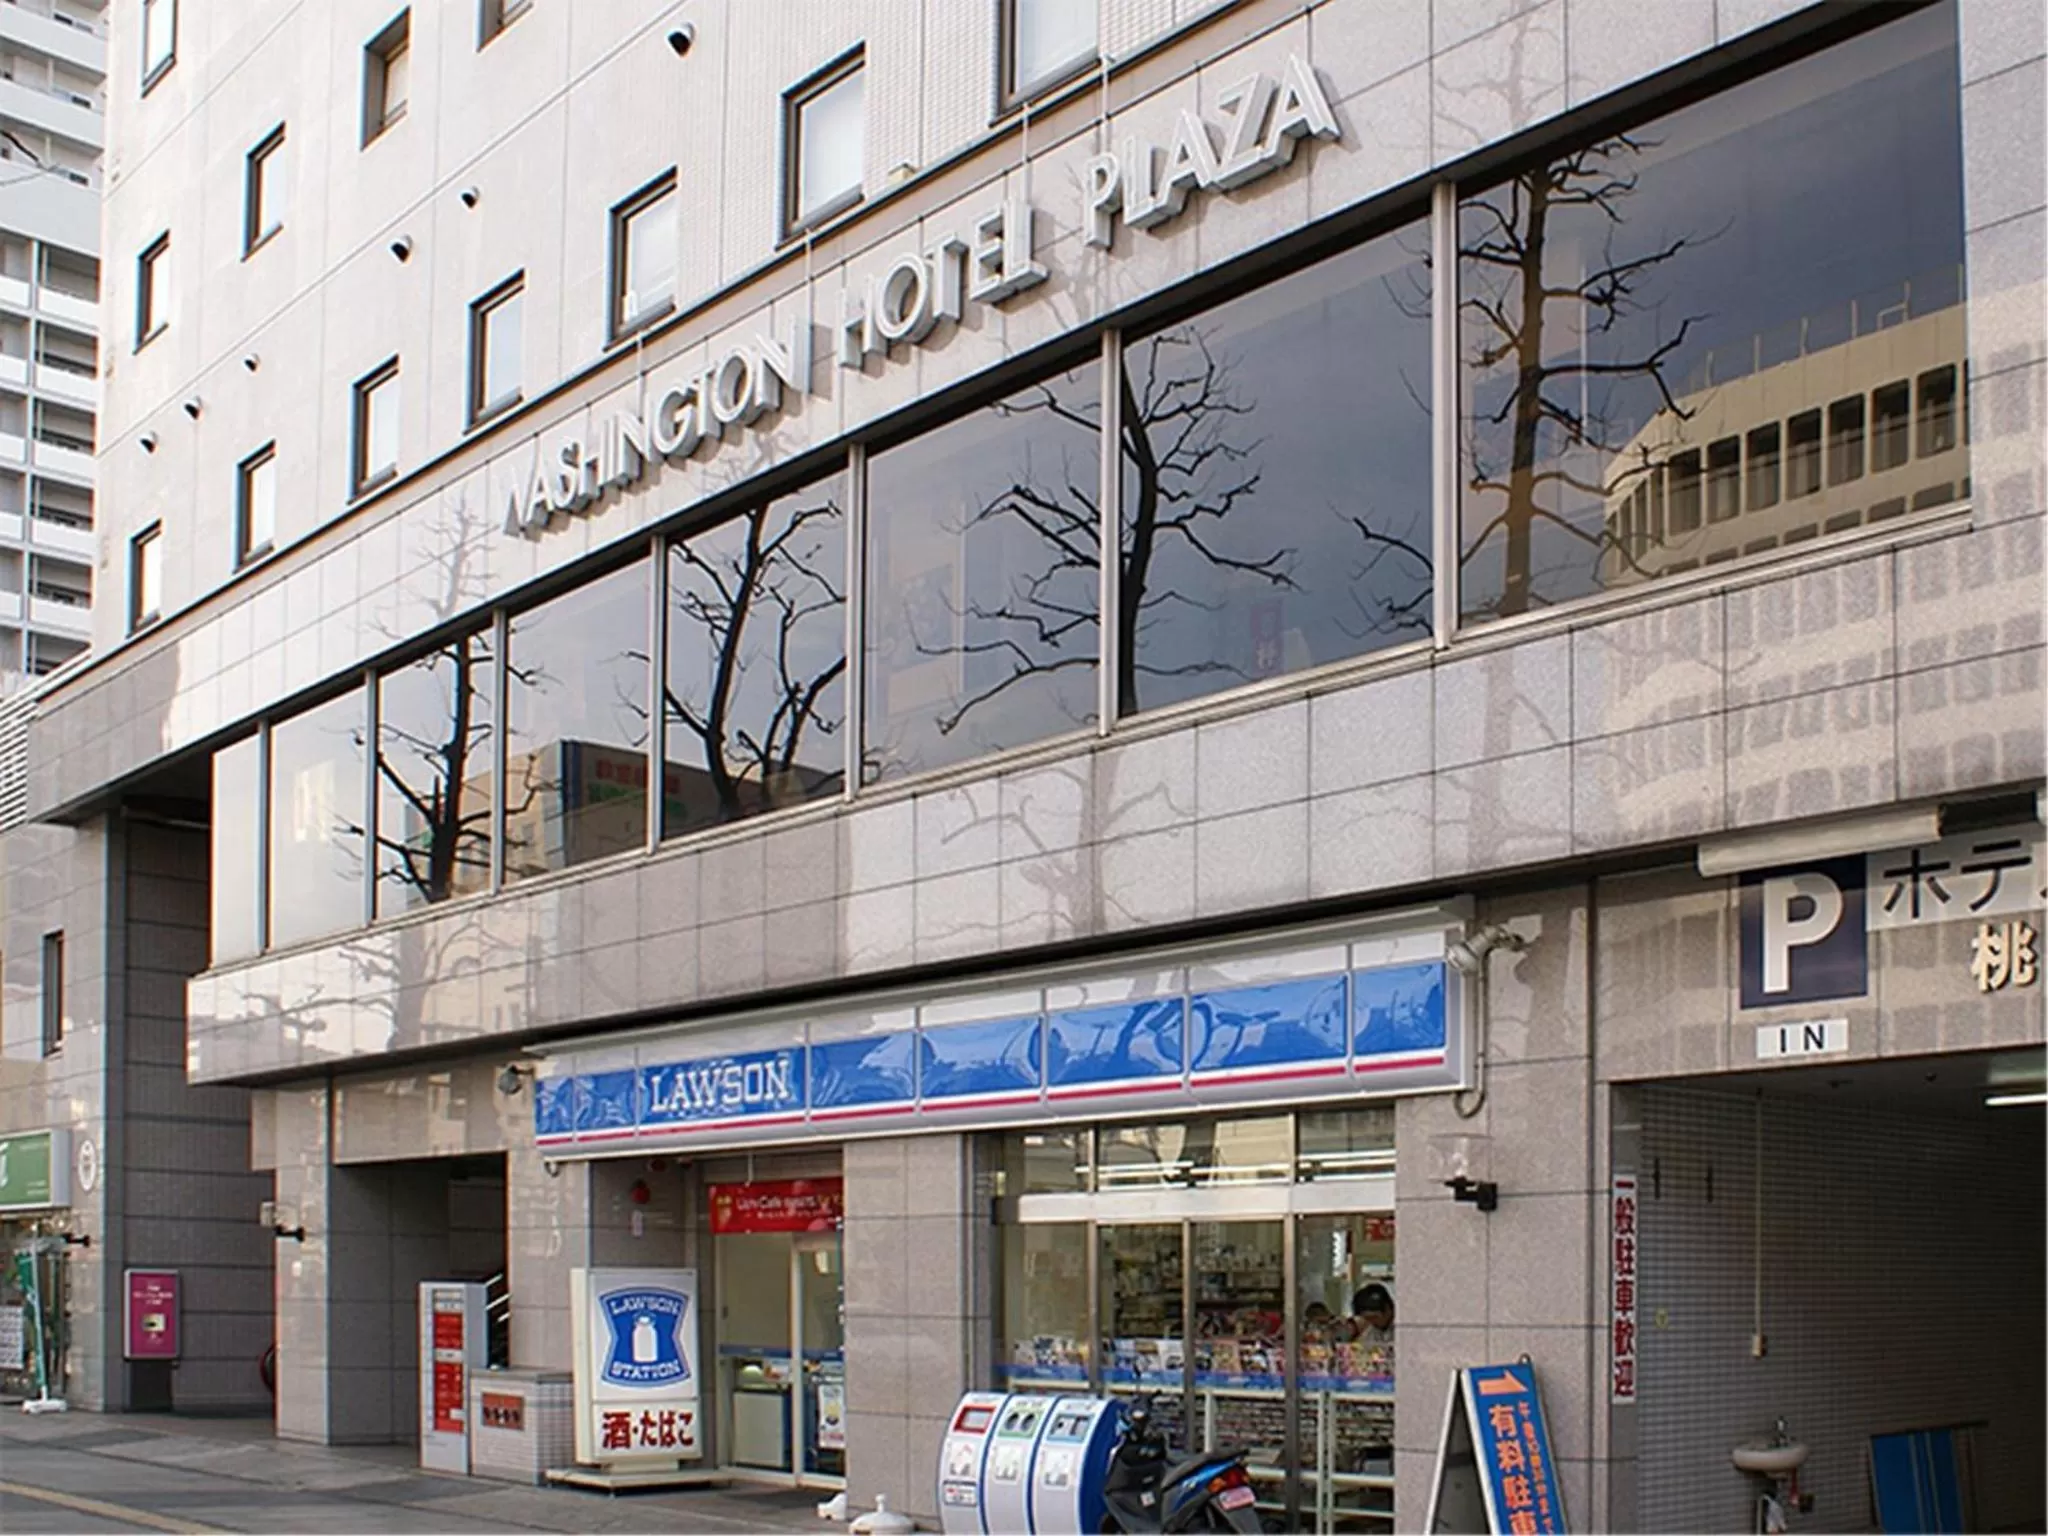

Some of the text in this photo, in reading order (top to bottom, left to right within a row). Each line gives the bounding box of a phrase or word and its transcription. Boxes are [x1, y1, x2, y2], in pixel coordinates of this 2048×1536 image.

[502, 53, 1341, 538] WASHINGTON HOTEL PLAZA
[1883, 839, 2047, 918] ホテ
[1763, 872, 1842, 993] P
[1971, 921, 2037, 993] 桃
[1779, 1024, 1825, 1053] IN
[651, 1059, 789, 1113] LAWSON
[610, 1296, 681, 1315] LAWSON
[611, 1361, 681, 1379] STATION
